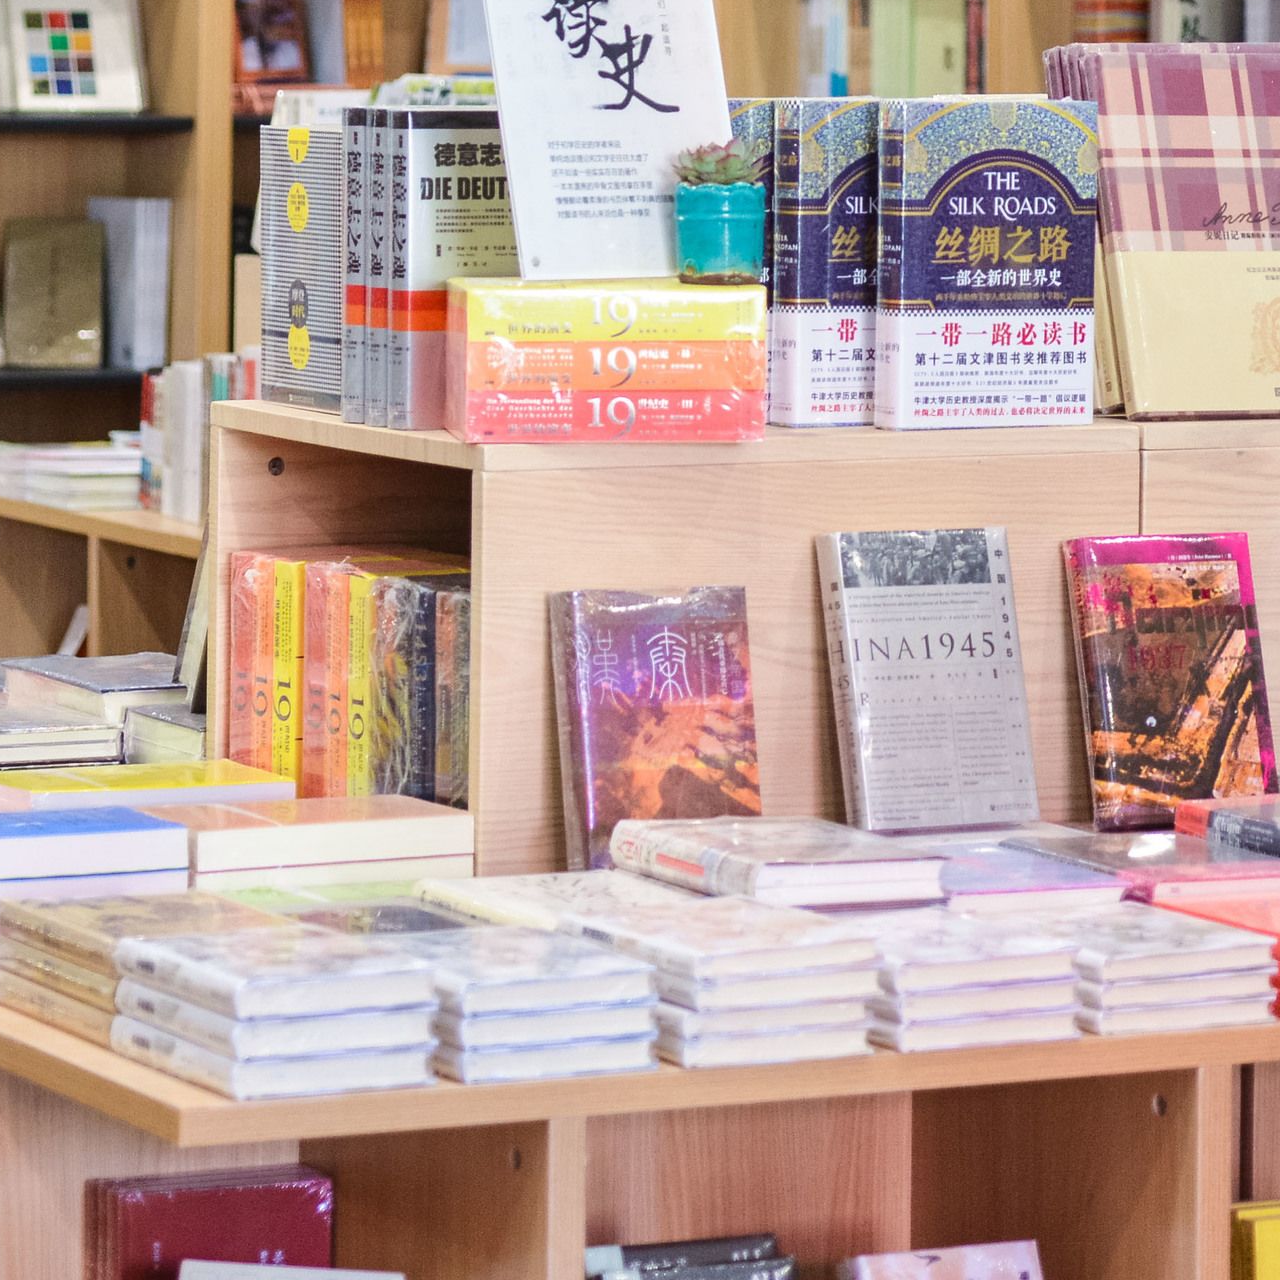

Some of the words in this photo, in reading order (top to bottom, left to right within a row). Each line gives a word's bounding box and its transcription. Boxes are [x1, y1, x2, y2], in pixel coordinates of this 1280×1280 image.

[434, 142, 505, 168] 德意志
[420, 177, 453, 201] DIE
[457, 177, 511, 201] DEUT
[984, 171, 1020, 190] THE
[949, 196, 985, 216] SILK
[994, 196, 1057, 221] ROADS
[1203, 201, 1269, 228] Anne
[931, 225, 1073, 266] 丝绸之路
[940, 267, 1062, 288] 一部全新的世界史
[591, 293, 639, 338] 19
[915, 321, 1087, 348] 一带一路必读书
[588, 346, 637, 388] 19
[914, 351, 1088, 366] 第十二届文津图书奖推荐图书
[587, 396, 636, 440] 19
[273, 679, 292, 722] 19
[348, 697, 365, 741] 19
